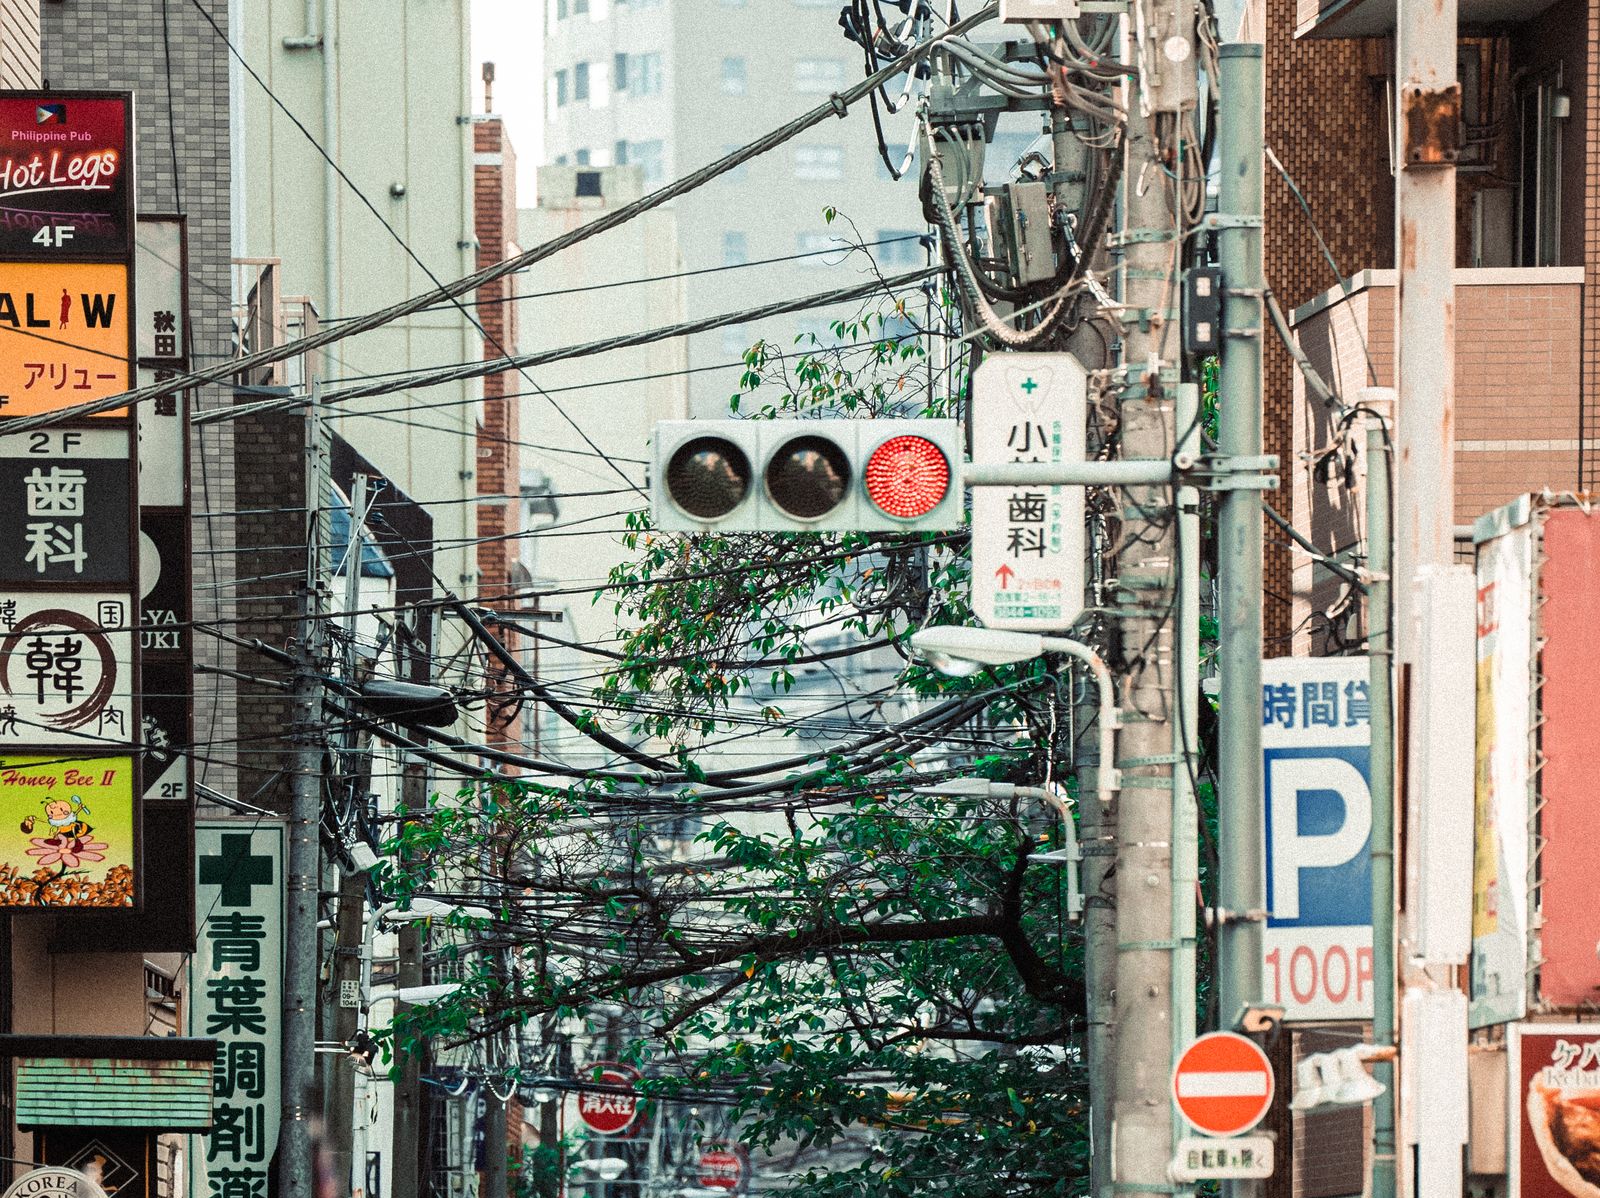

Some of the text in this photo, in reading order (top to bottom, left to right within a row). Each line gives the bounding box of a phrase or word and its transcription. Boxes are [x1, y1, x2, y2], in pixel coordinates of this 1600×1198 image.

[11, 130, 92, 142] Philippine Pub
[50, 152, 115, 190] Legs
[32, 225, 76, 247] 4F
[24, 363, 116, 391] アリュー
[1007, 421, 1048, 558] 小歯科
[24, 466, 88, 574] 歯科
[98, 601, 125, 630] 国
[26, 637, 84, 705] 韓
[98, 705, 125, 736] 肉
[1, 769, 57, 790] Honey
[64, 769, 94, 787] Bee
[160, 783, 183, 798] 2F
[1270, 757, 1372, 920] P
